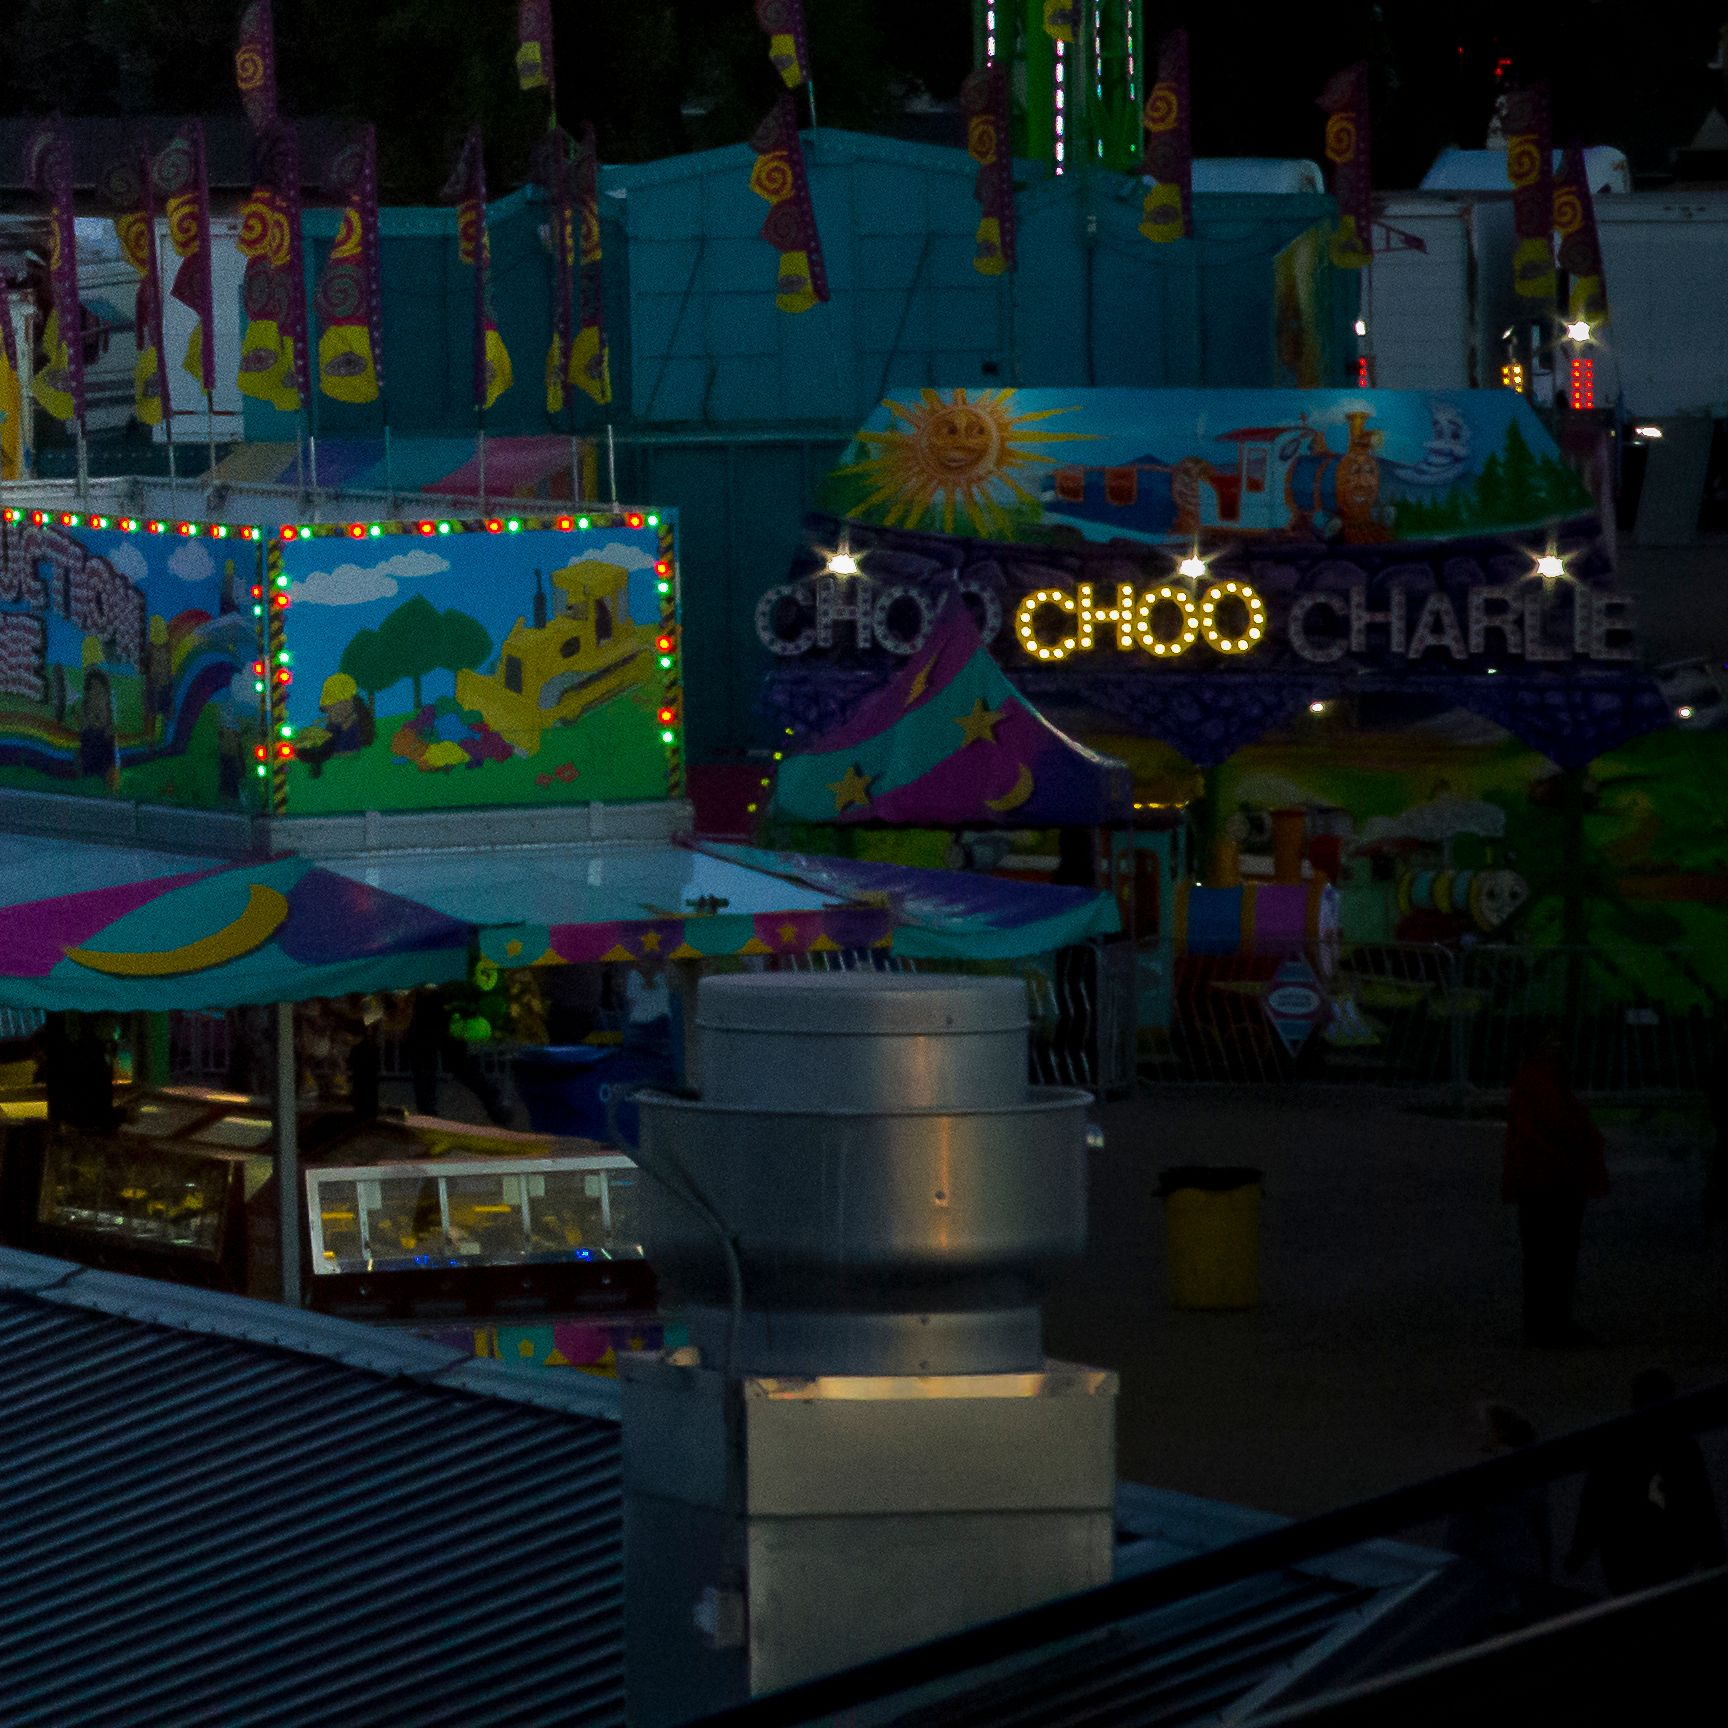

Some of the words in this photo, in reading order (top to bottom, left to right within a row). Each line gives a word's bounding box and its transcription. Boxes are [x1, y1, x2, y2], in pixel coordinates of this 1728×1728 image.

[754, 578, 1002, 657] CHOO
[1014, 580, 1268, 663] CHOO
[1287, 580, 1640, 663] CHARLIE
